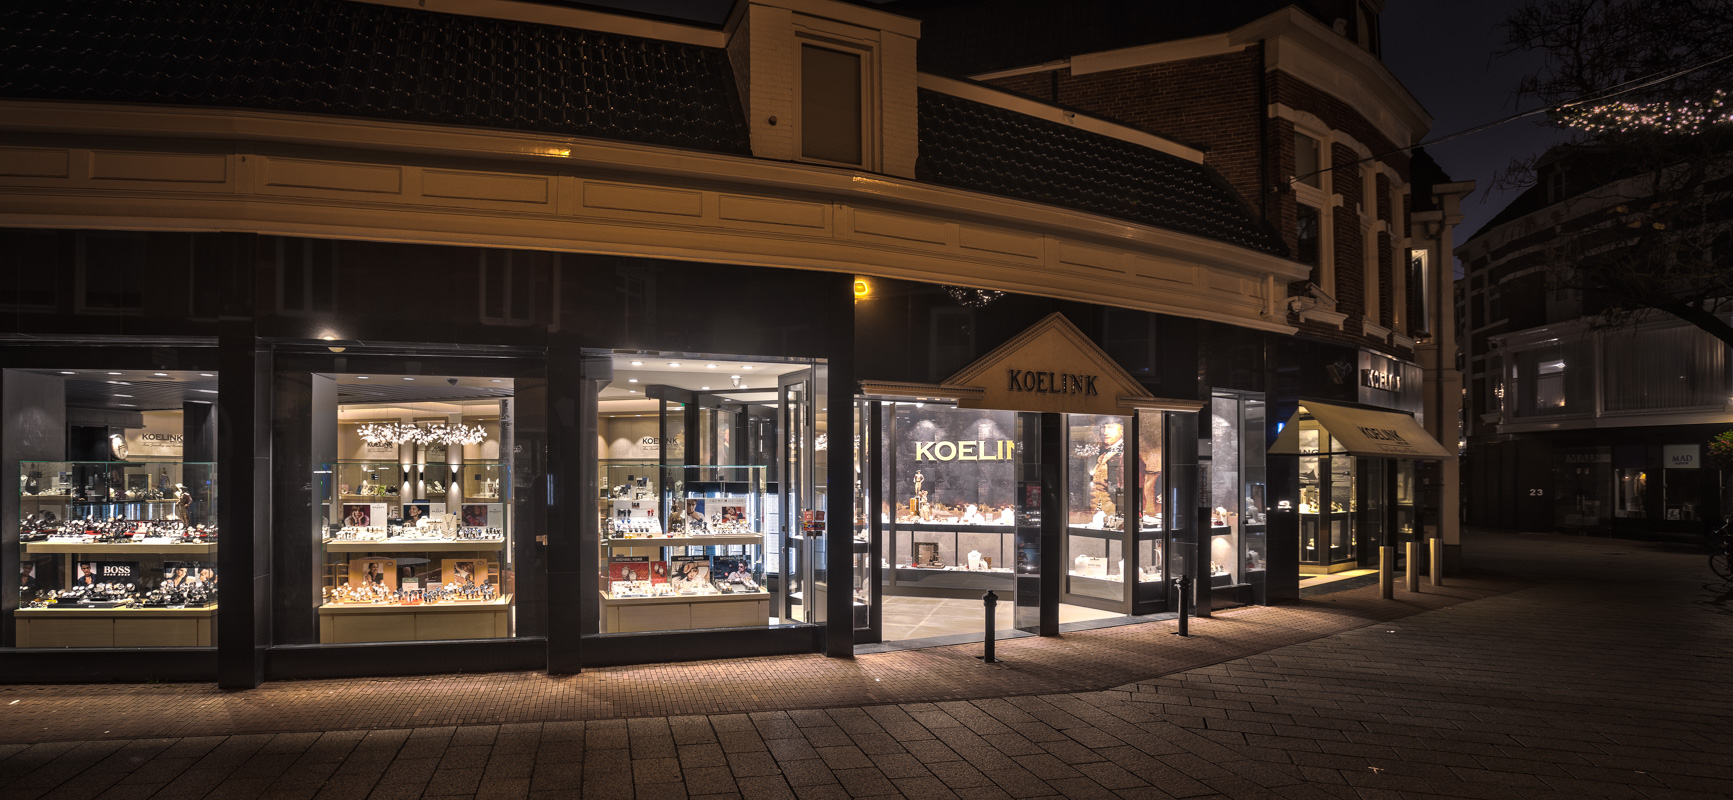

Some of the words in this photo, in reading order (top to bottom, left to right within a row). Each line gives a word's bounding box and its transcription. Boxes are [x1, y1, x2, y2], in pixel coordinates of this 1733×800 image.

[1008, 369, 1099, 397] KOELINK
[142, 433, 183, 442] KOELINK
[1529, 488, 1544, 496] 23
[104, 565, 131, 574] BOSS
